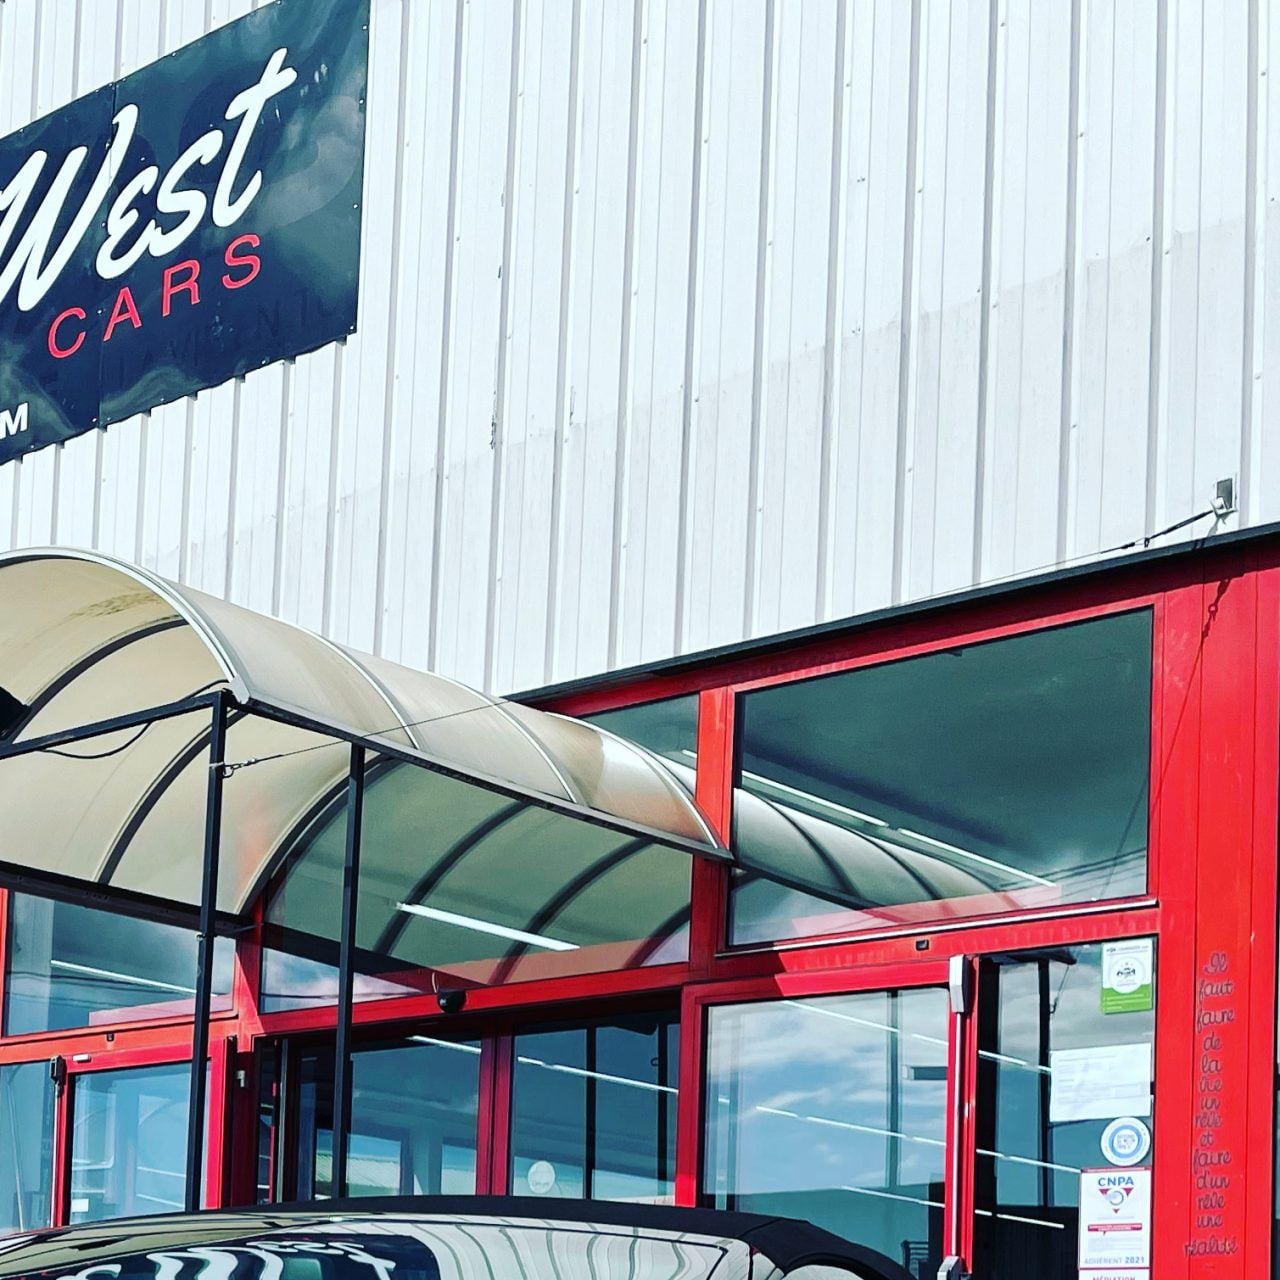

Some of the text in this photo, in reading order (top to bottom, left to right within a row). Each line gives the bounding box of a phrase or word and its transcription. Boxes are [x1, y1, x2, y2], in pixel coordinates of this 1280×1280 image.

[47, 234, 262, 359] CARS
[1203, 1031, 1222, 1051] de
[1201, 1054, 1221, 1074] la
[1098, 1176, 1135, 1187] CNPA
[1196, 1213, 1224, 1228] une
[1125, 1255, 1145, 1265] 2021
